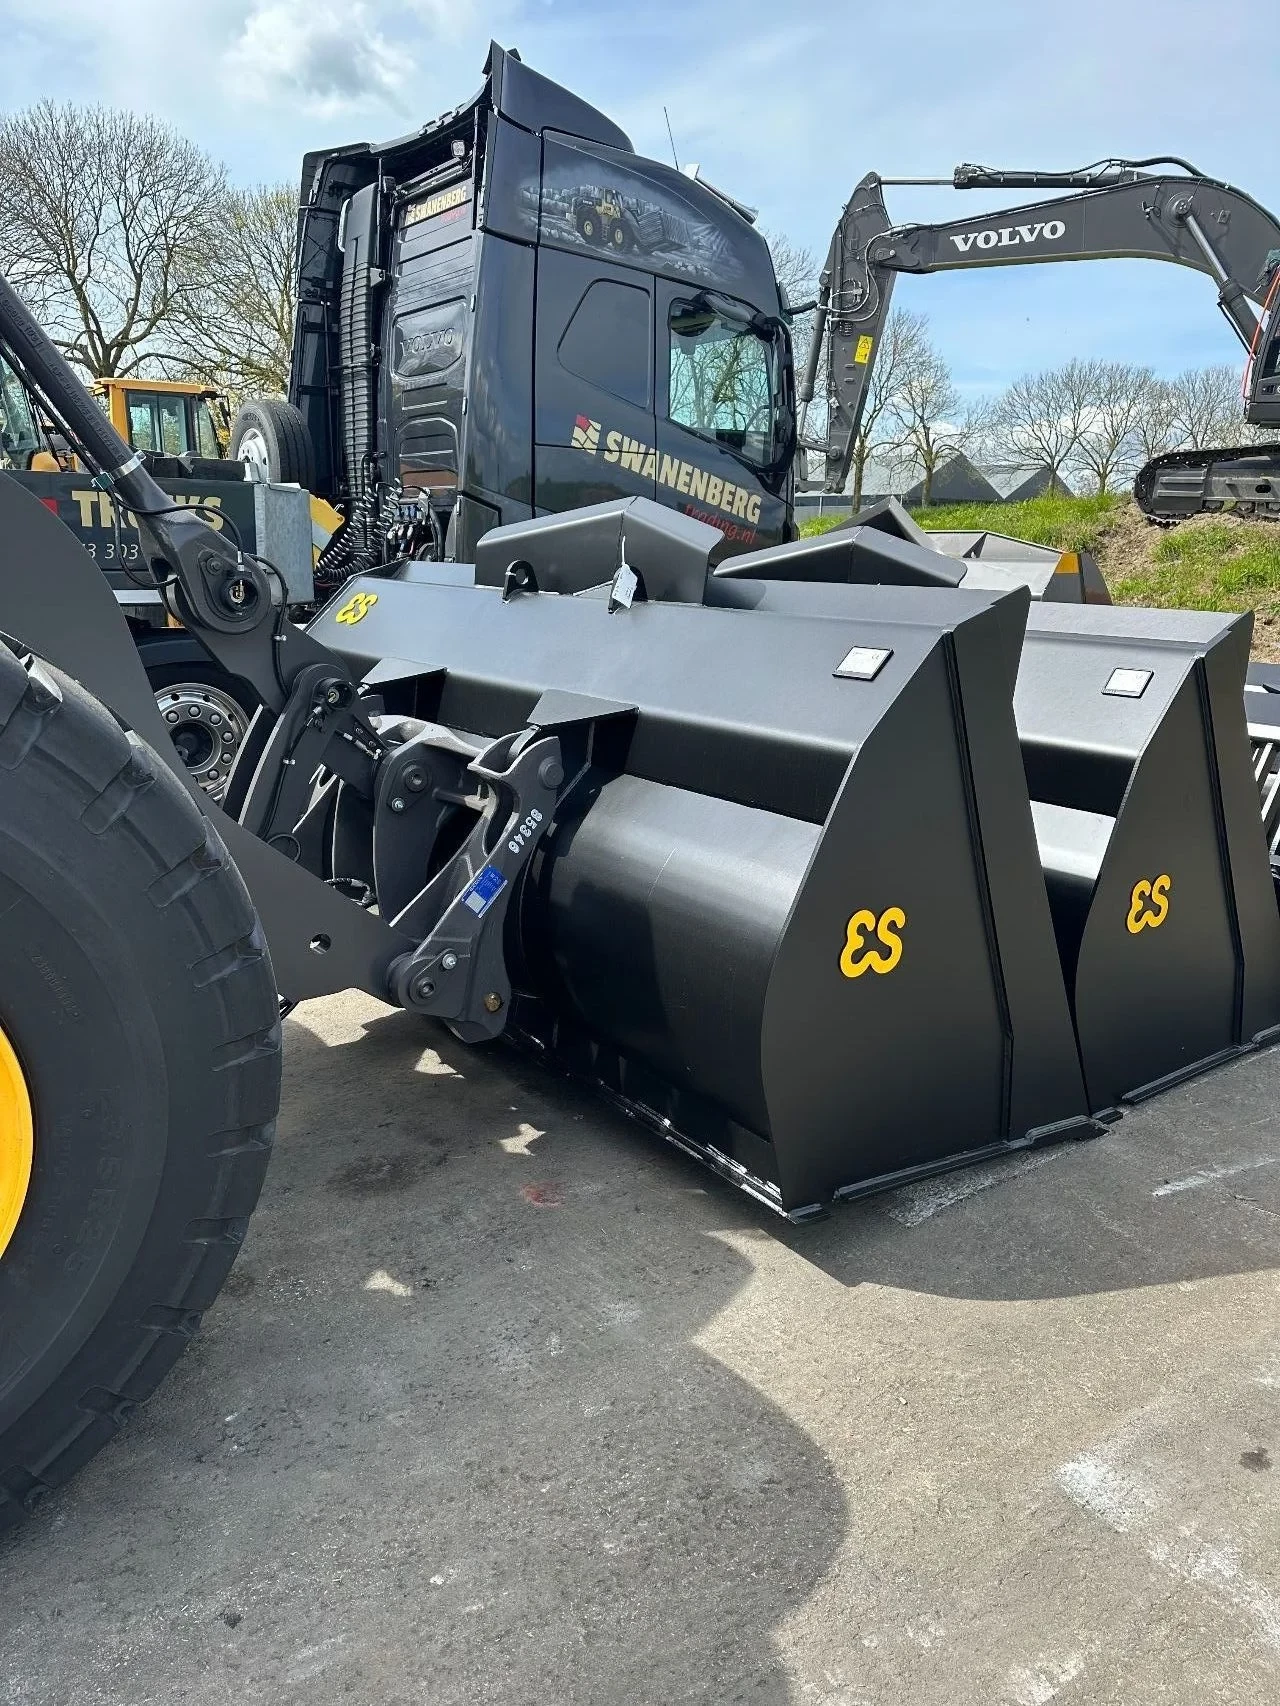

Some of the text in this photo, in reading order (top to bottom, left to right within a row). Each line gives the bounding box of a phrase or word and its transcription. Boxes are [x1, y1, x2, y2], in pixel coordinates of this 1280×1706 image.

[949, 220, 1066, 252] VOLVO
[604, 430, 762, 525] SWANENBERG
[71, 490, 224, 531] TRS
[508, 808, 543, 854] 85346
